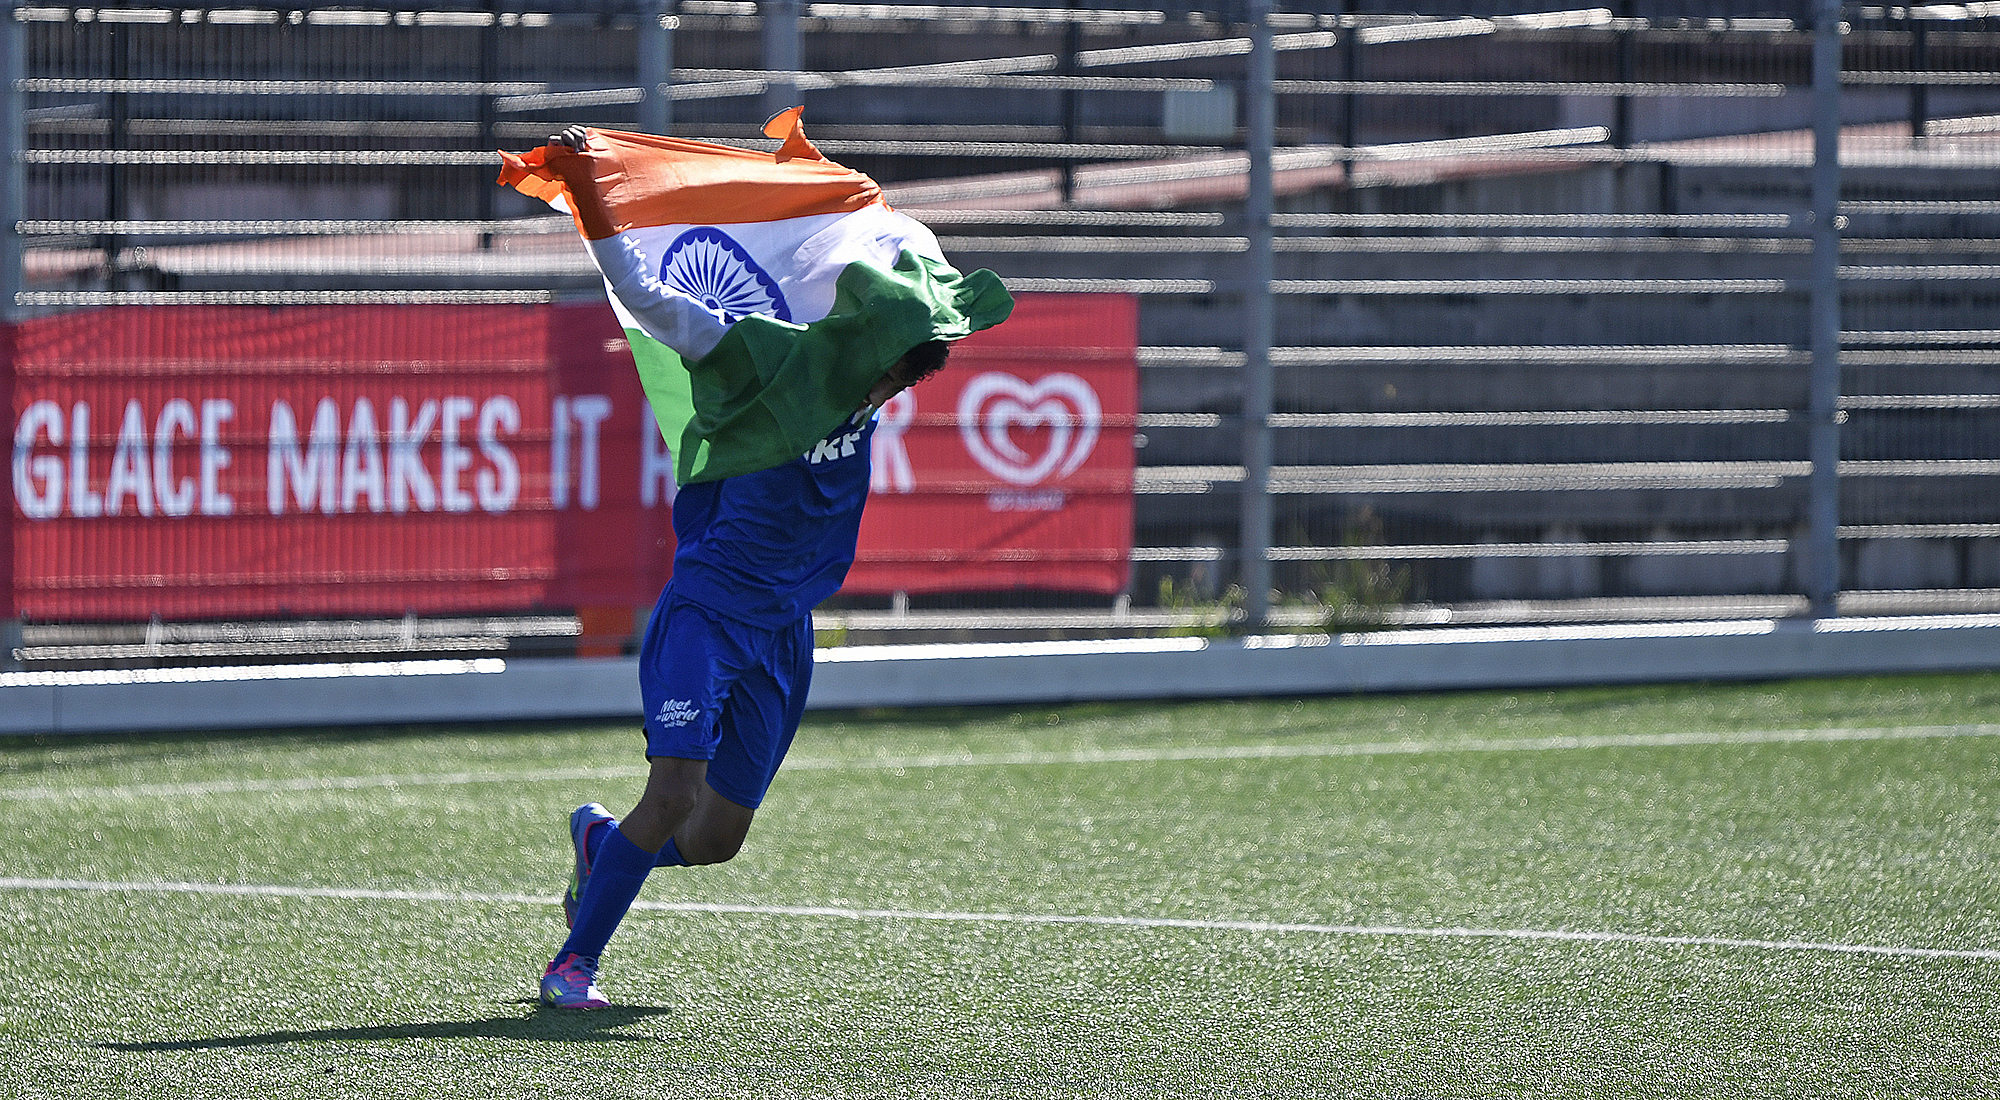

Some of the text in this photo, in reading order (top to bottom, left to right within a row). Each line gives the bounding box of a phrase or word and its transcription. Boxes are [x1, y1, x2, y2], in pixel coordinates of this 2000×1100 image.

[12, 399, 234, 518] GLACE
[267, 396, 520, 515] MAKES
[552, 395, 613, 512] IT
[661, 698, 692, 714] Meet
